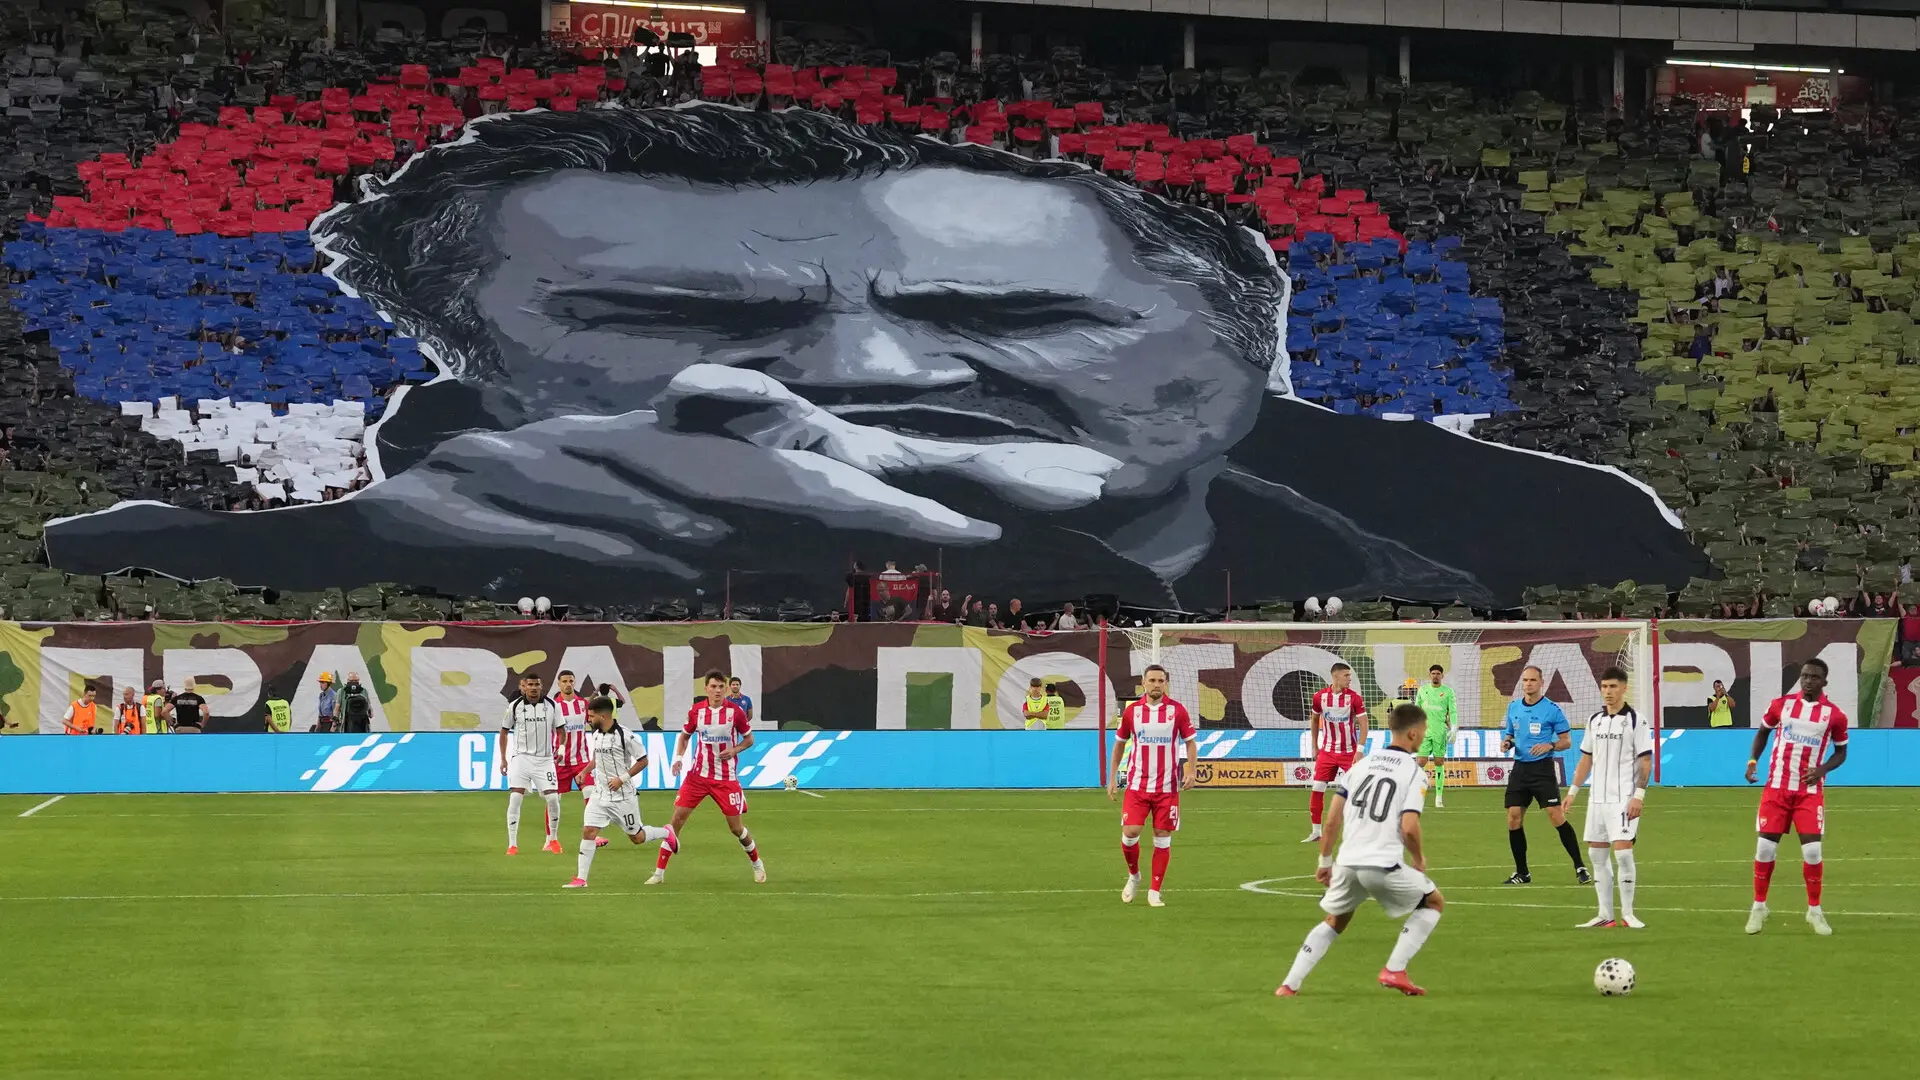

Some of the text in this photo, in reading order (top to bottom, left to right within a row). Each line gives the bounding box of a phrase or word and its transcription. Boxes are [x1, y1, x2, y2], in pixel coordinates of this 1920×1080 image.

[1218, 769, 1278, 780] MOZZART
[729, 792, 741, 806] 60
[1351, 774, 1397, 823] 40
[623, 813, 635, 827] 10
